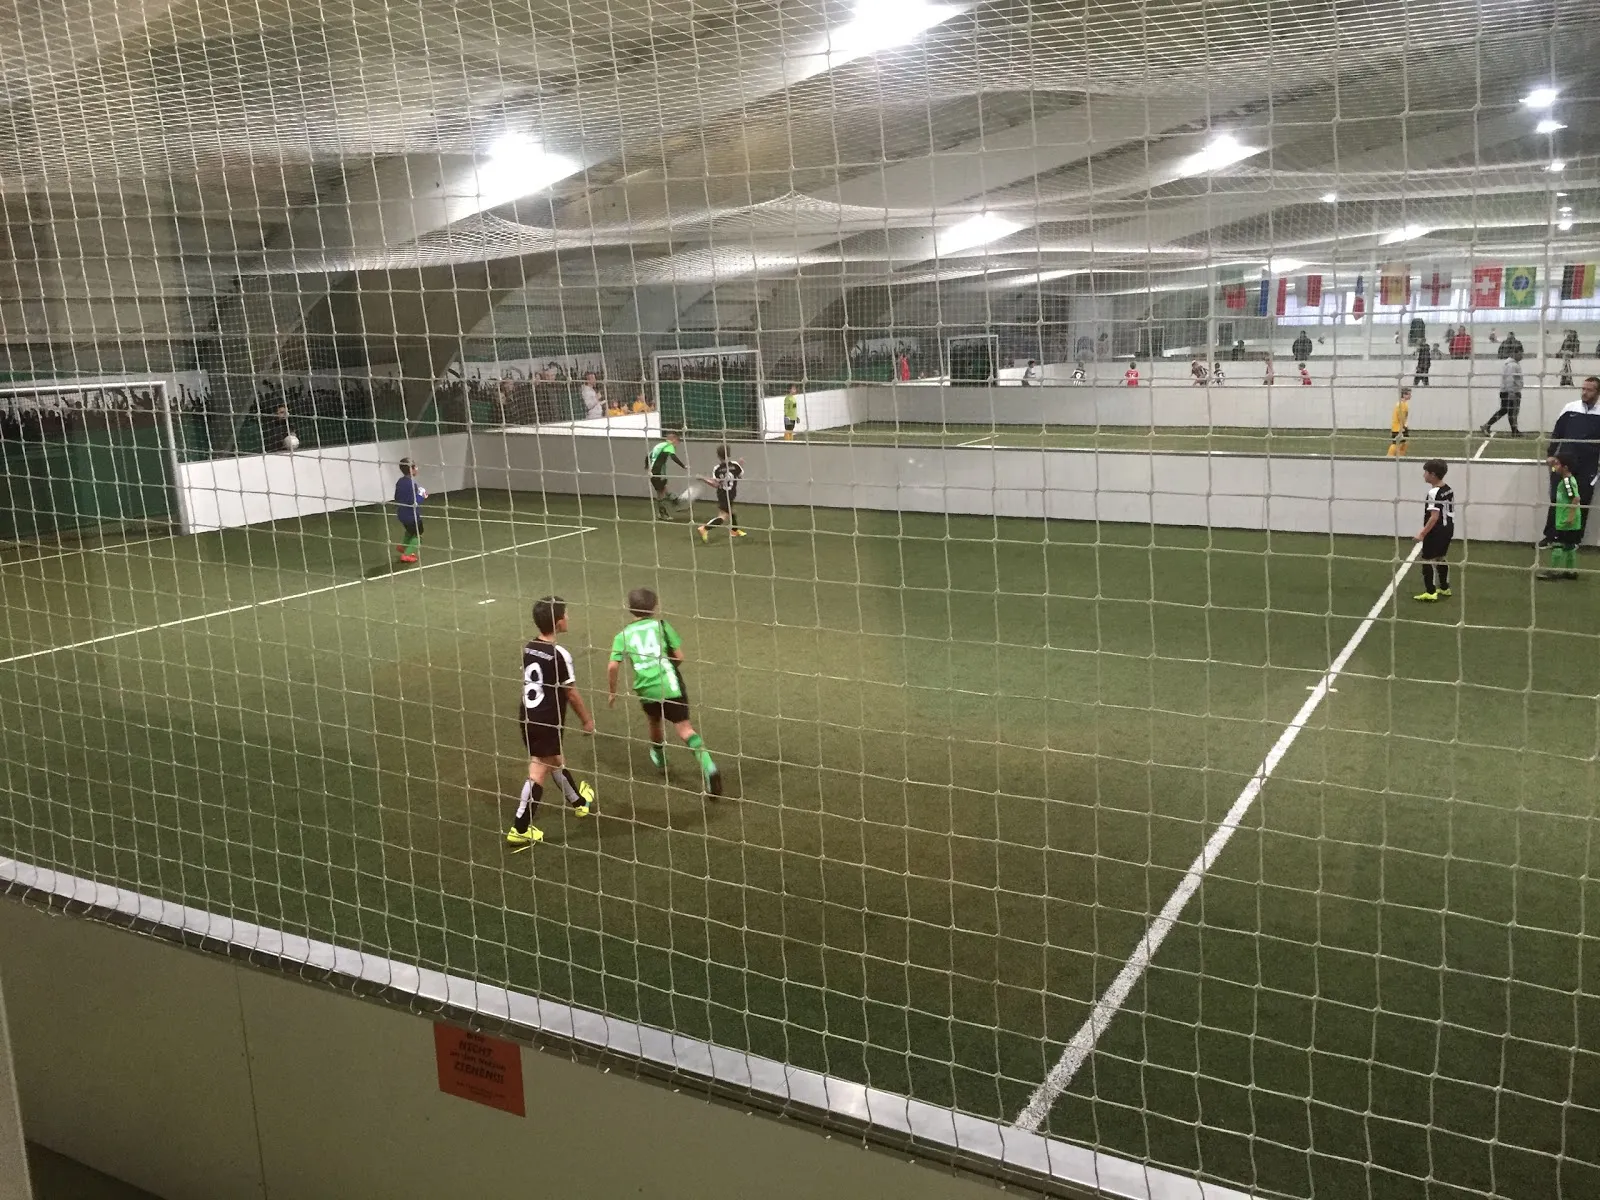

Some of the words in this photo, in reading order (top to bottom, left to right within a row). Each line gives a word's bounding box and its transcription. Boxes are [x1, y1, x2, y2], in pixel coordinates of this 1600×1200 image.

[630, 628, 661, 661] 14
[524, 662, 545, 709] 8
[459, 1040, 493, 1057] NICHT
